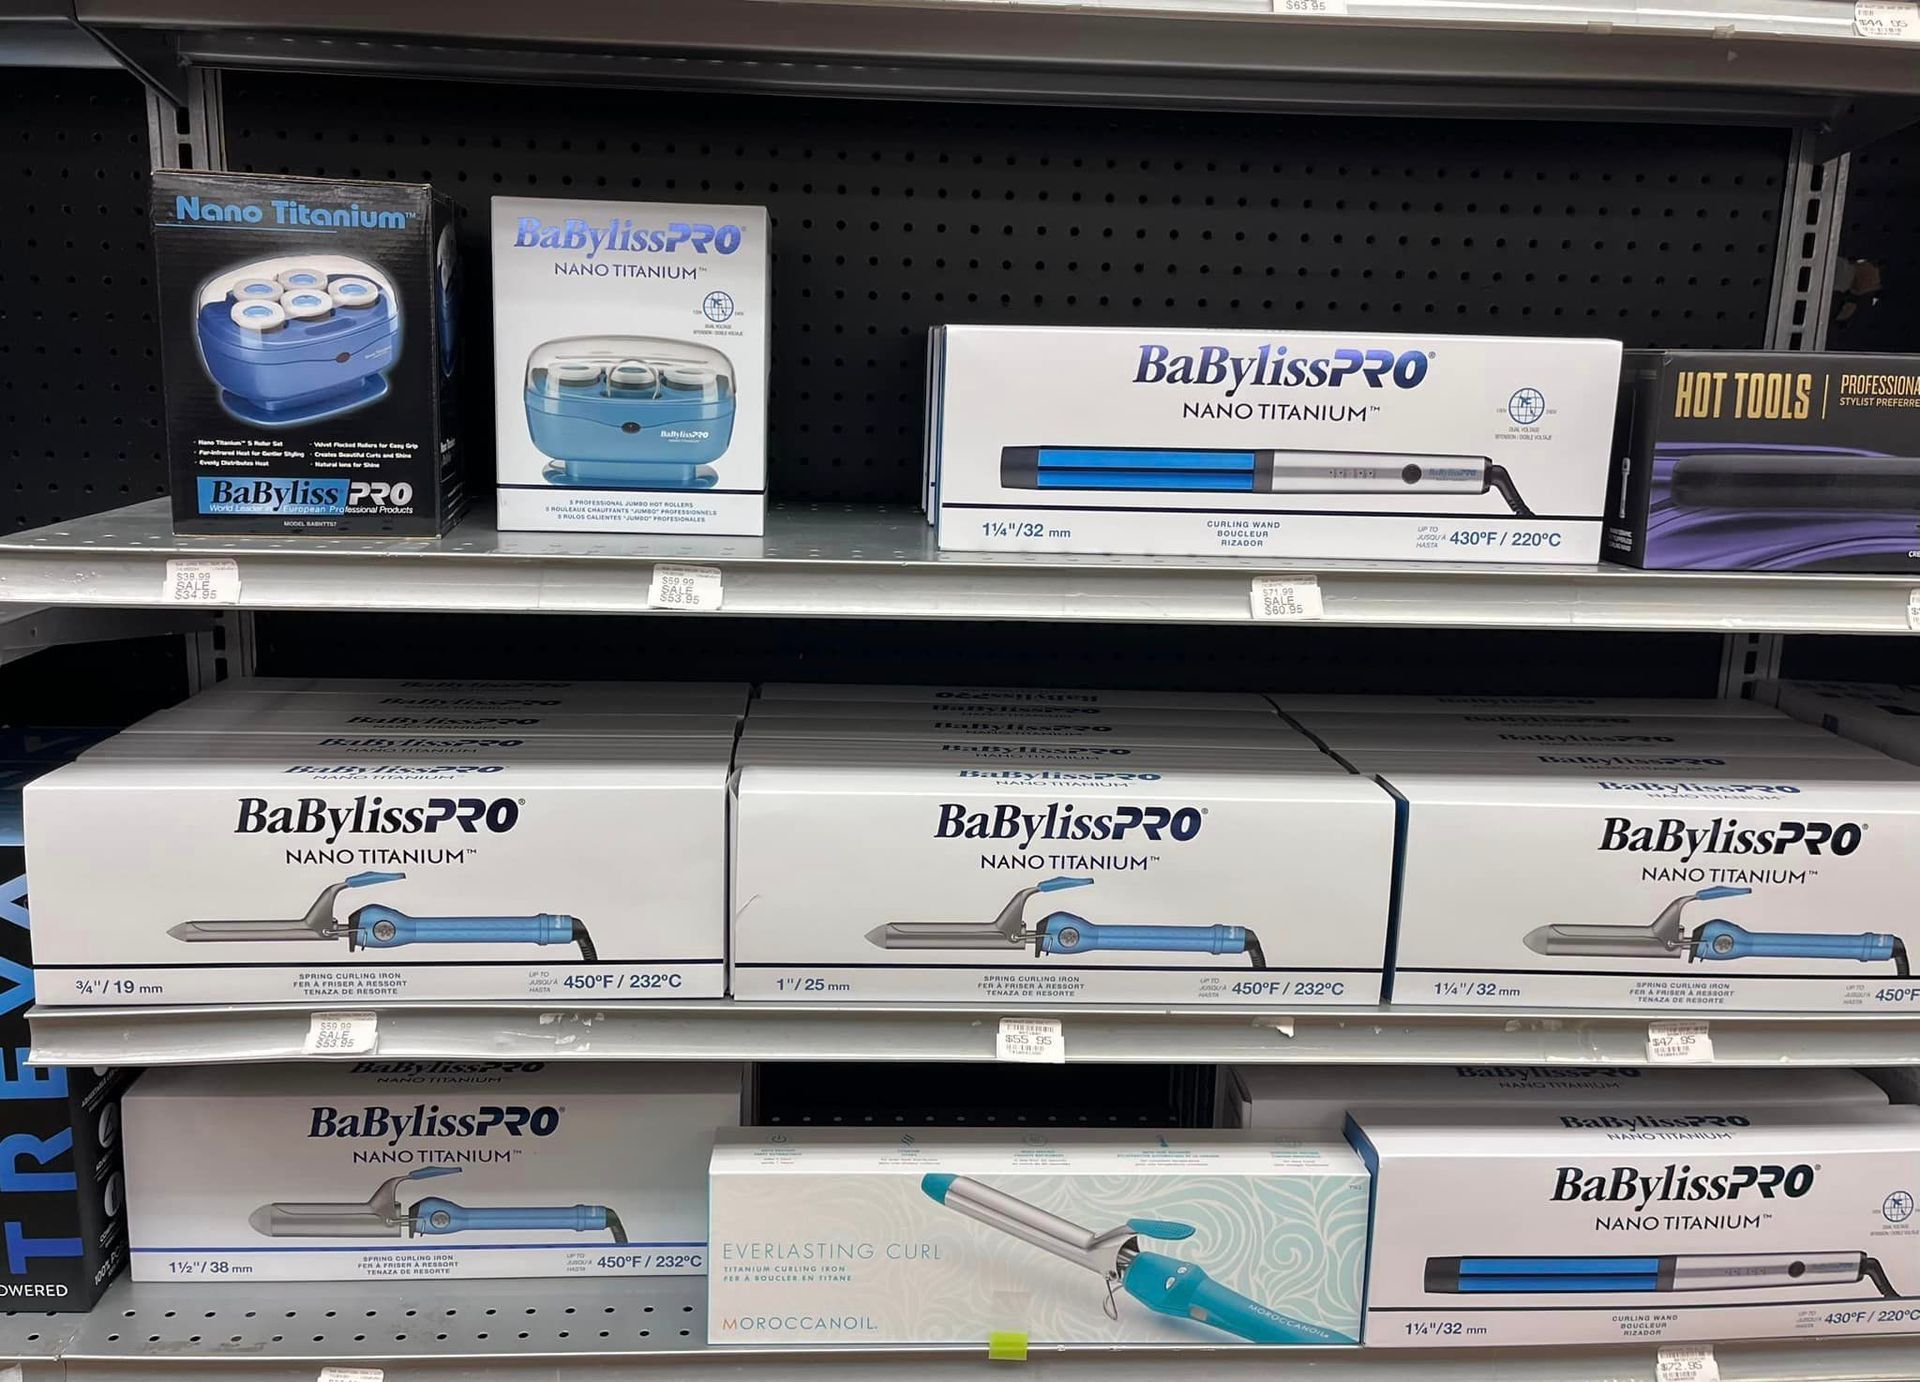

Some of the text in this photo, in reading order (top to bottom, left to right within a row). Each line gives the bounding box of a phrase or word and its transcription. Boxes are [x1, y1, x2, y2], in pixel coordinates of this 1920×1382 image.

[176, 196, 262, 223] Nano
[554, 262, 609, 276] NANO
[1674, 372, 1812, 420] HOT TOOLS
[1840, 396, 1874, 406] STYLIST
[1182, 402, 1253, 420] NANO
[212, 480, 413, 511] BaByliss PRO
[209, 504, 234, 512] World
[283, 506, 326, 514] European
[329, 505, 378, 514] Professional
[379, 506, 414, 514] Products
[1252, 521, 1280, 529] WAND
[1049, 529, 1070, 538] mm
[1216, 530, 1269, 538] BOUCLEUR
[1500, 532, 1508, 546] /
[1221, 539, 1263, 547] RIZADOR
[176, 581, 210, 591] SALE
[662, 576, 694, 585] $59.99
[174, 590, 217, 600] $34.95
[661, 584, 693, 596] SALE
[1263, 588, 1294, 596] $71.99
[660, 594, 700, 604] $53.95
[1264, 596, 1294, 606] SALE
[1264, 605, 1304, 616] $60.95
[318, 738, 524, 748] BaBylissPRO
[942, 745, 1132, 755] BaBylissPRO
[1537, 754, 1726, 766] BaBylissPRO
[284, 765, 506, 774] BaBylissPRO
[959, 770, 1162, 781] BaBylissPRO
[1596, 781, 1801, 794] BaBylissPRO
[286, 849, 354, 864] NANO
[981, 855, 1044, 870] NANO
[1641, 867, 1704, 882] NANO
[617, 974, 624, 989] /
[828, 982, 850, 991] mm
[139, 985, 163, 994] mm
[1282, 982, 1290, 996] /
[1498, 988, 1520, 996] mm
[319, 1030, 350, 1040] SALE
[316, 1039, 355, 1048] $53.95
[350, 1061, 546, 1076] BaBylissPRO
[1560, 1116, 1750, 1131] BaBylissPRO
[353, 1150, 414, 1163] NANO
[1596, 1216, 1659, 1231] NANO
[723, 1243, 942, 1260] EVERLASTING CURL
[645, 1256, 651, 1268] /
[1466, 1326, 1487, 1335] mm
